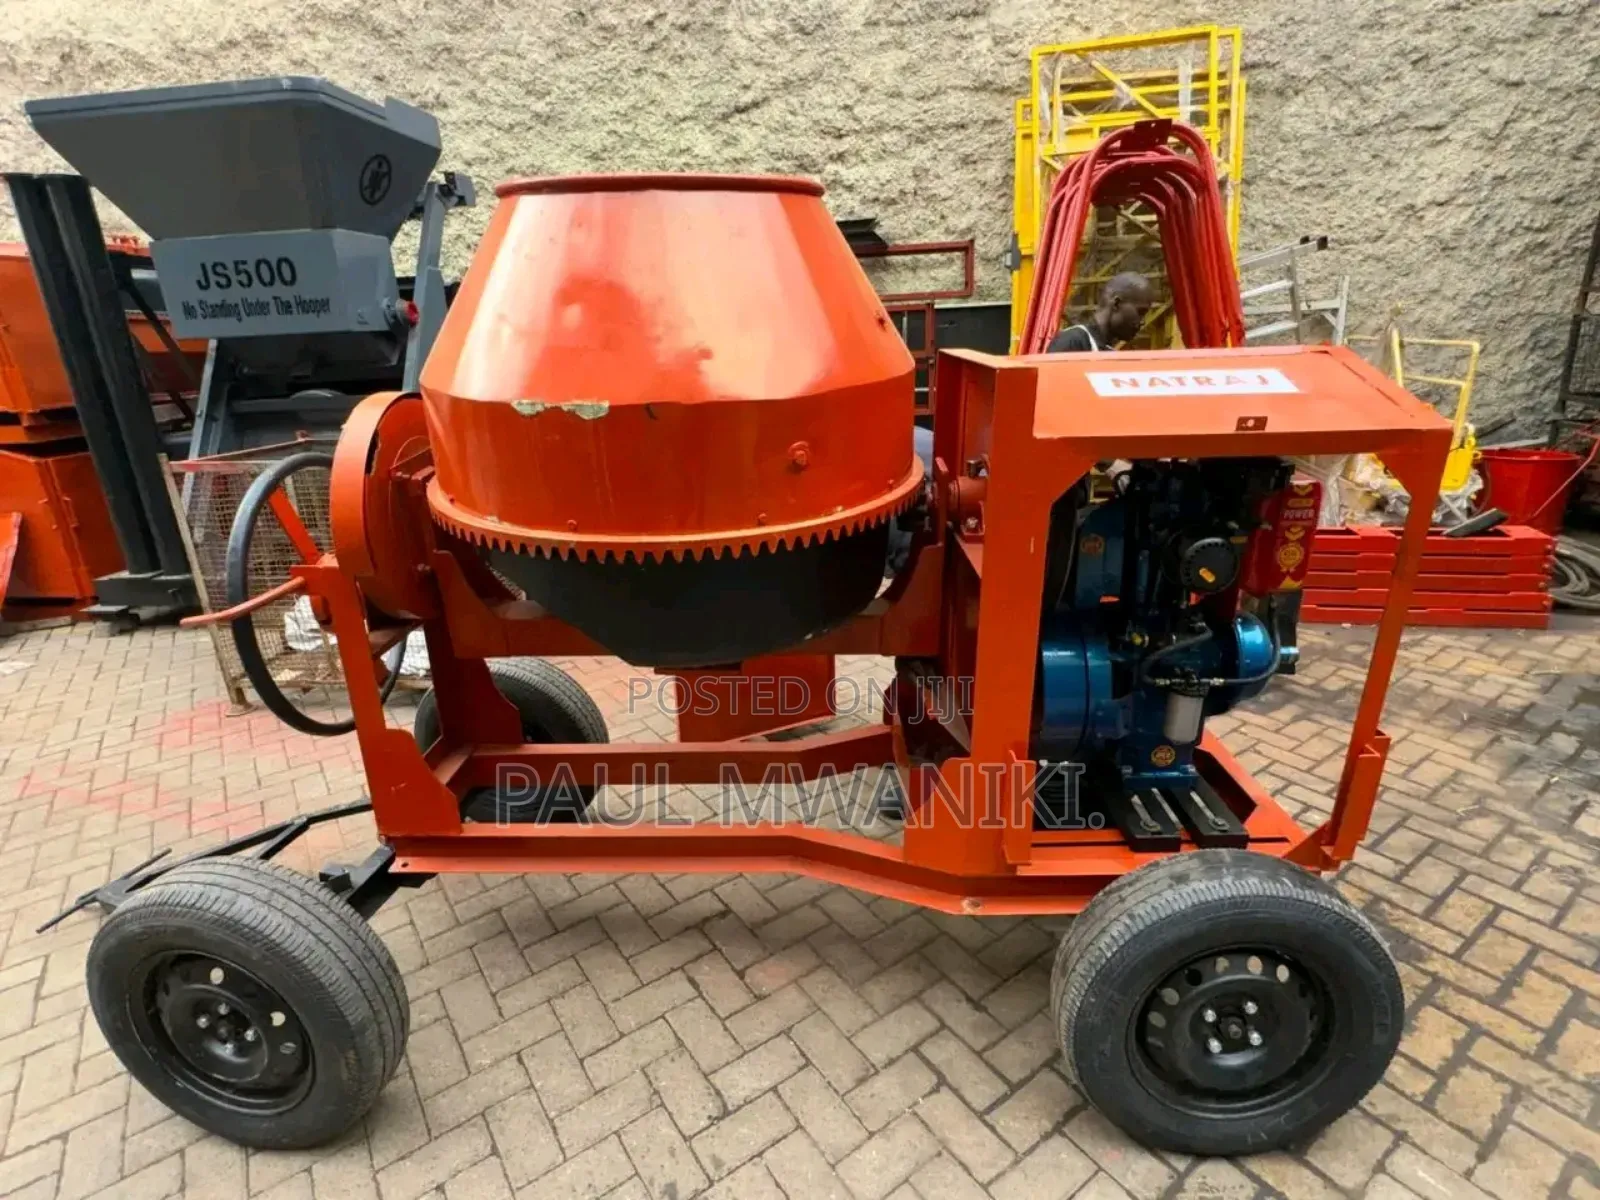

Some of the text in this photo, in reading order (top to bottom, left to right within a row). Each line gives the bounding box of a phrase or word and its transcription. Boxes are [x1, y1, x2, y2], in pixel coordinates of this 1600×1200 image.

[195, 257, 297, 290] JS500
[182, 301, 198, 320] No
[199, 299, 243, 322] Standing
[243, 297, 272, 318] Under
[273, 296, 294, 315] The
